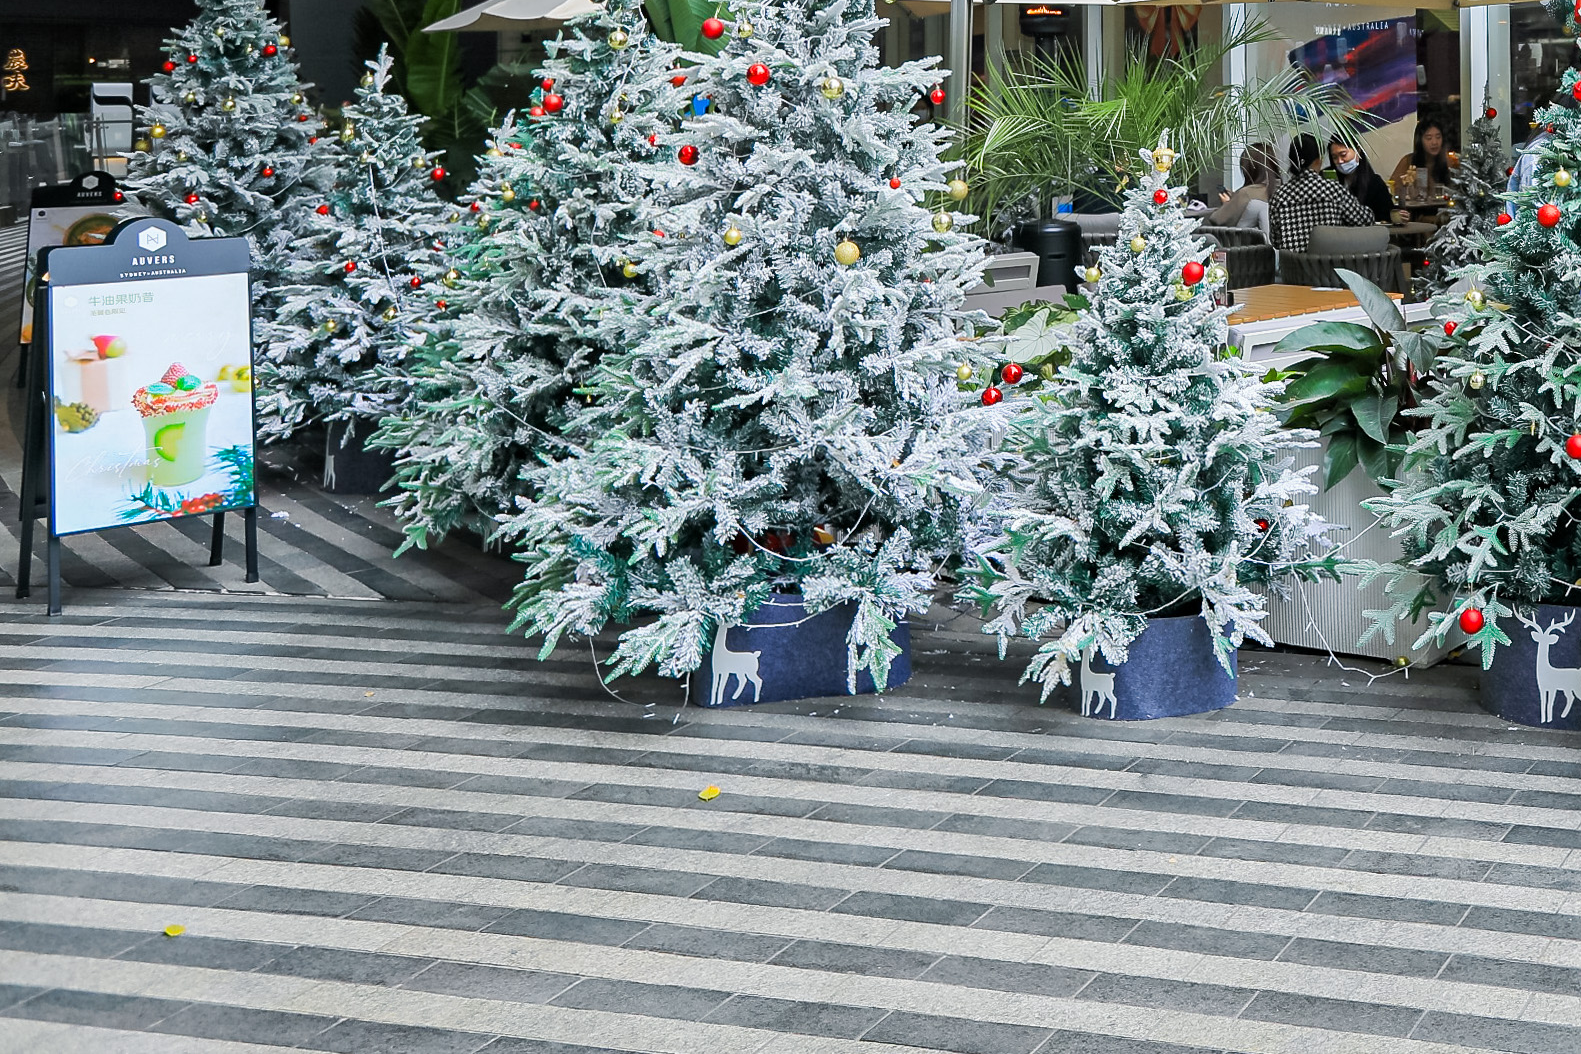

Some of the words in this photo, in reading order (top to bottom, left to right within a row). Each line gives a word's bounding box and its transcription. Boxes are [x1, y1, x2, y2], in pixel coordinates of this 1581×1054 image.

[131, 254, 175, 266] AUVERS
[88, 291, 154, 307] 牛油果奶昔
[65, 444, 164, 484] Christmas
